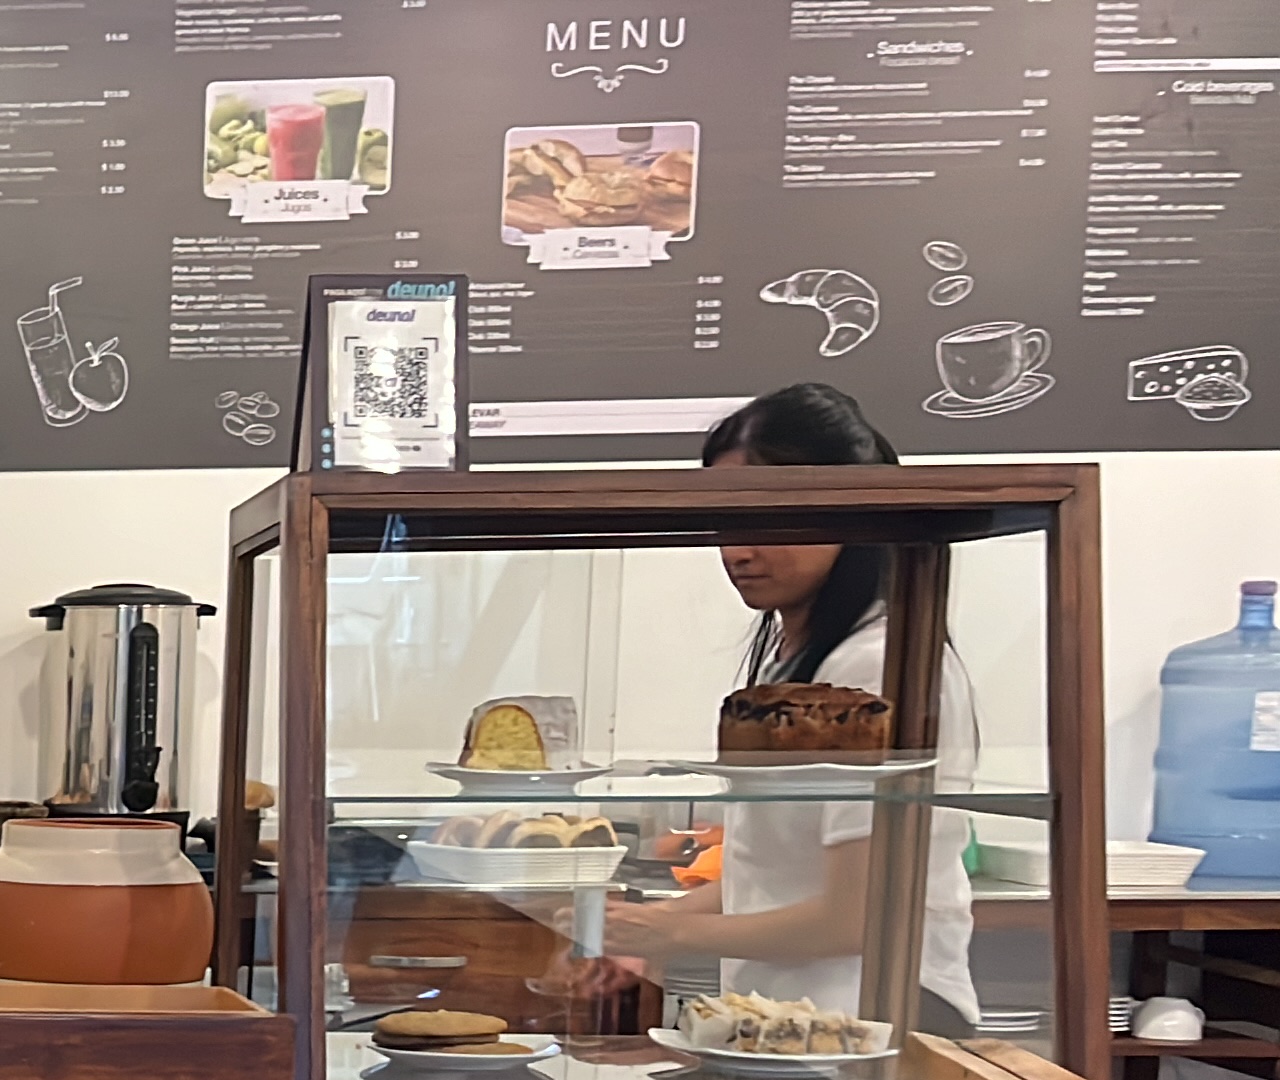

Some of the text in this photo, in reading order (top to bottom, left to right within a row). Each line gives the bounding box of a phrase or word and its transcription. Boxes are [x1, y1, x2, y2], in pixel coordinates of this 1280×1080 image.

[545, 17, 686, 51] MENU
[877, 41, 965, 53] Sandwiches
[1172, 80, 1274, 94] Cold beverages
[273, 188, 320, 201] Juices
[280, 203, 312, 214] Jugos
[578, 237, 616, 247] Beers
